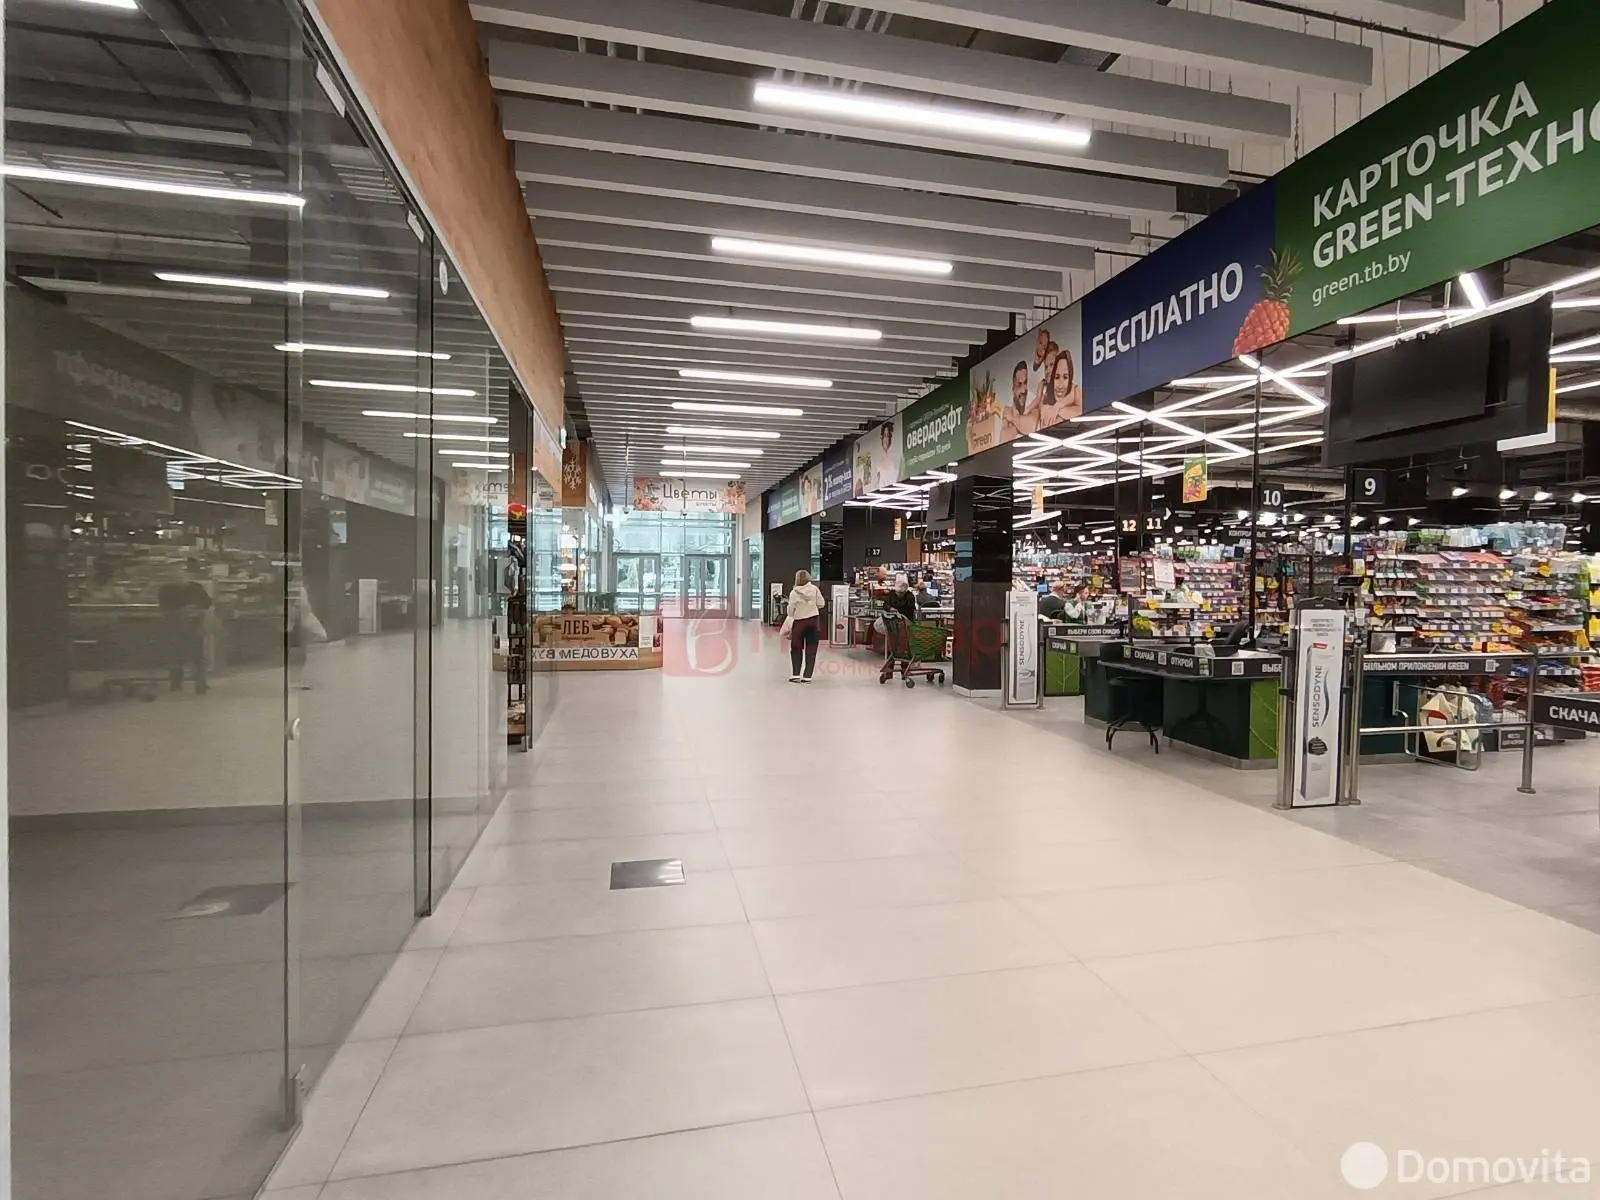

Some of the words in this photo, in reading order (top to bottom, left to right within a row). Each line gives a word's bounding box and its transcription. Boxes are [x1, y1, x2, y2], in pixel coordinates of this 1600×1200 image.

[1313, 80, 1539, 227] КАРТОЧКА
[1312, 251, 1411, 306] green.tb.by
[1092, 262, 1243, 356] БЕСПЛАТНО
[906, 404, 963, 450] овердрафт
[663, 483, 717, 499] Цветы
[1365, 477, 1376, 496] 9
[1263, 489, 1281, 507] 10
[1122, 520, 1136, 531] 12
[1146, 518, 1162, 530] 11
[561, 648, 638, 659] МЕДОВУХА
[1134, 650, 1155, 661] СКАЧАЙ
[1171, 656, 1194, 669] ОТКРОЙ
[1262, 663, 1282, 673] ВЫБЕ
[1363, 662, 1397, 671] БИЛЬНОМ
[1399, 662, 1446, 671] ПРИЛОЖЕНИИ
[1447, 662, 1470, 671] GREEN
[1311, 665, 1323, 728] SENSODYNE
